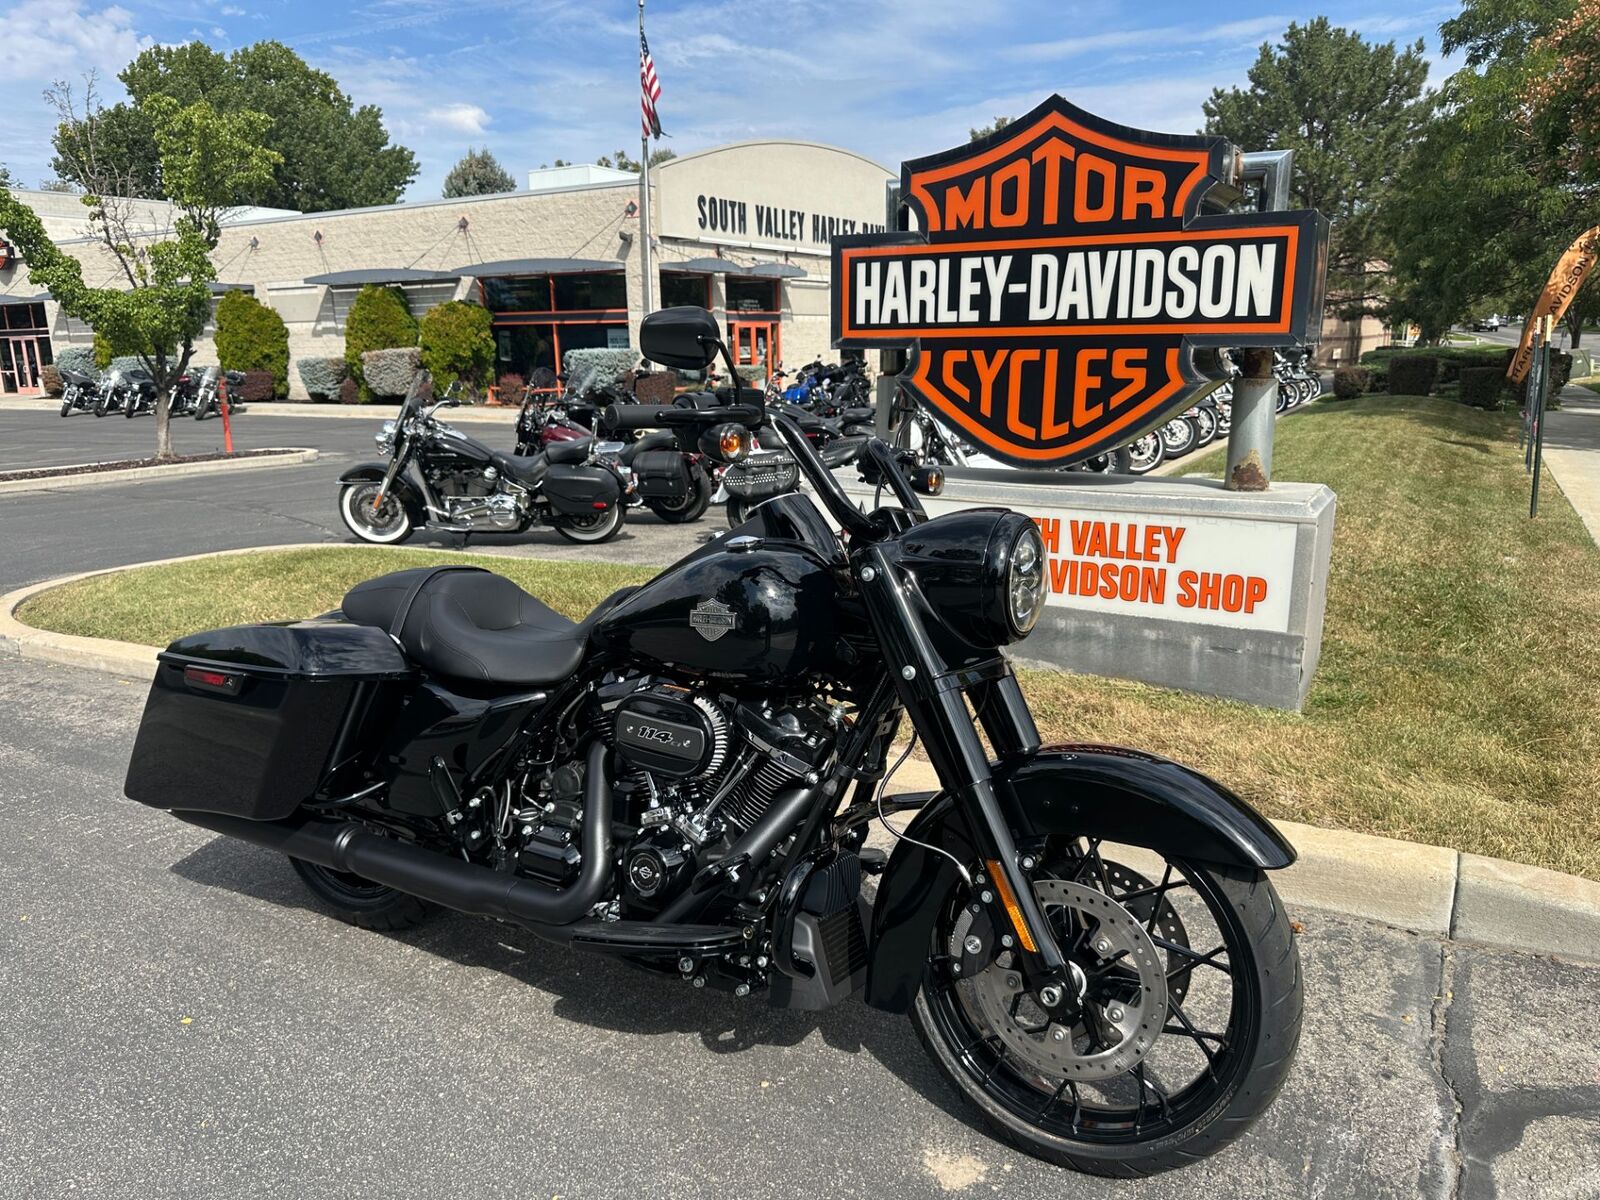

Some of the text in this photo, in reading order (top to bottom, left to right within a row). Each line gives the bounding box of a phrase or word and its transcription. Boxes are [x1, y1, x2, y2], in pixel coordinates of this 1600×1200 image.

[944, 136, 1167, 231] MOTOR
[697, 194, 747, 235] SOUTH
[755, 204, 805, 242] VALLEY
[855, 243, 1277, 325] HARLEY-DAVIDSON
[942, 348, 1148, 441] CYCLES
[1069, 519, 1186, 564] VALLEY
[1176, 570, 1268, 614] SHOP
[638, 726, 673, 743] 114
